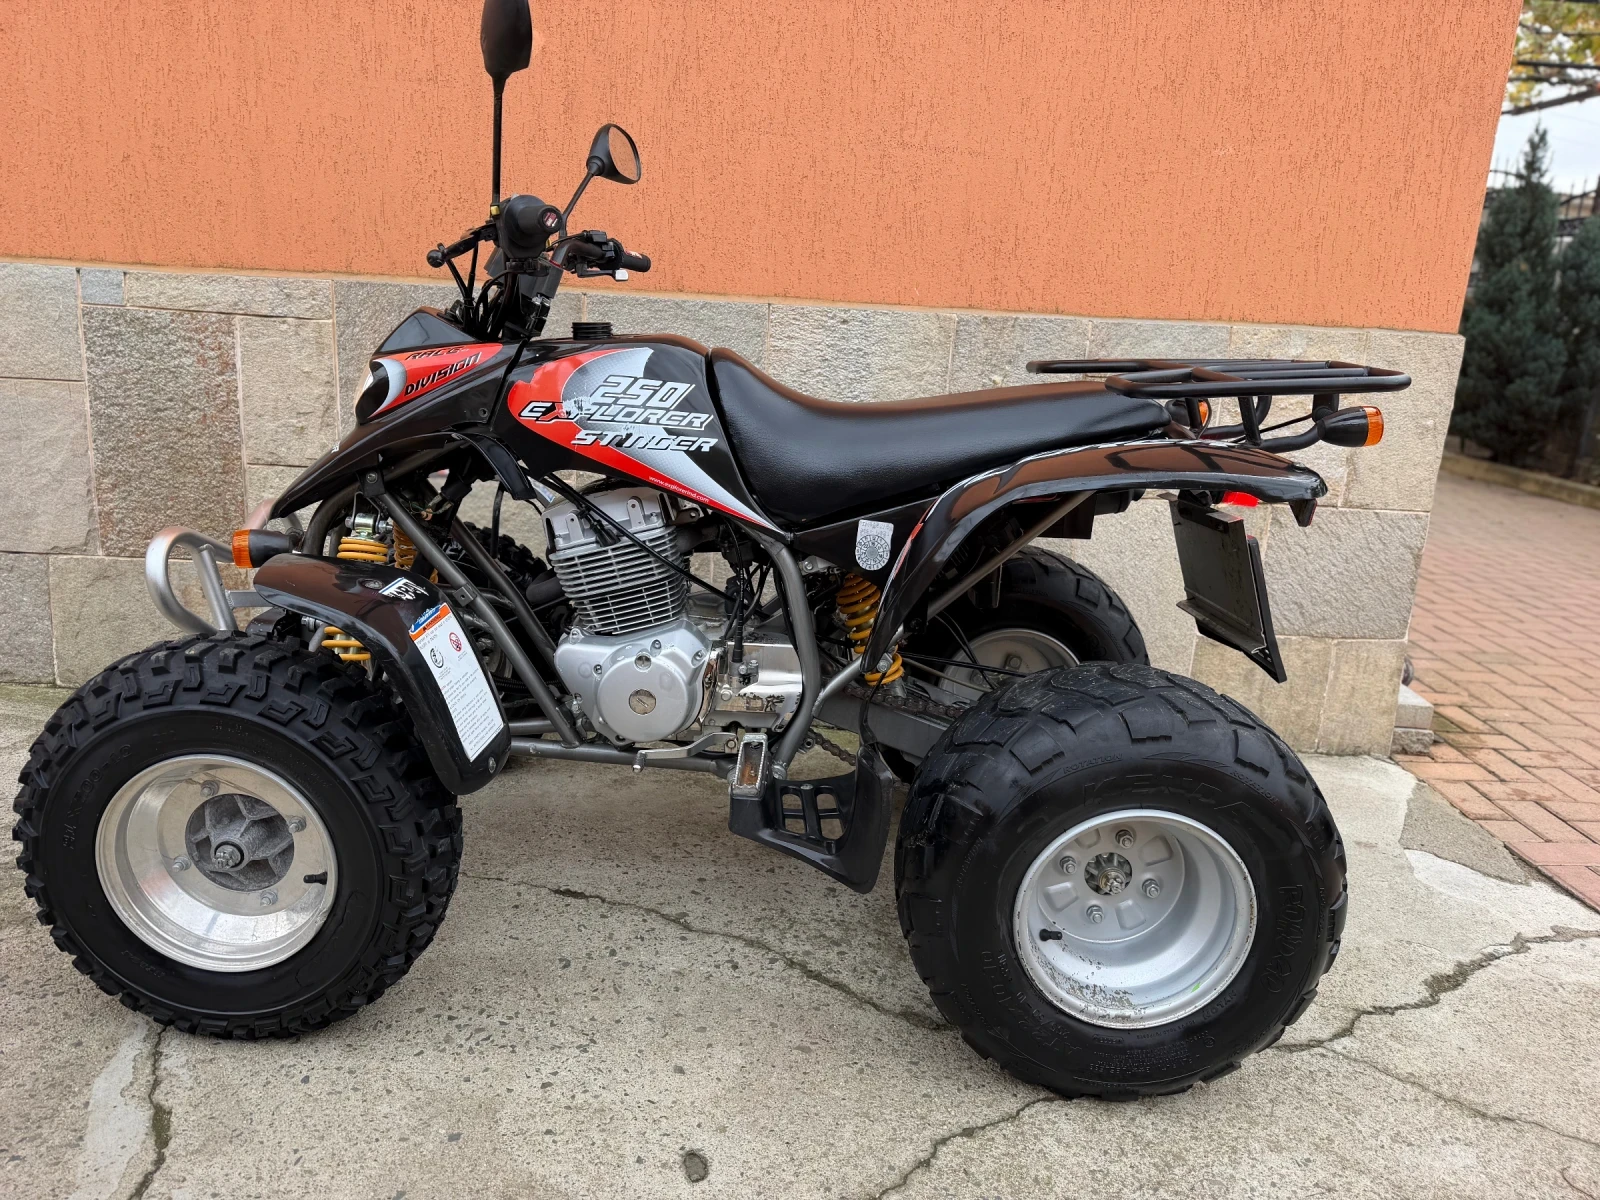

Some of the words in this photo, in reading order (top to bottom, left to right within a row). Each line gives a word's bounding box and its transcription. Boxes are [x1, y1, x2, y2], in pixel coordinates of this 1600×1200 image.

[404, 352, 482, 396] DIVISION
[590, 375, 695, 409] 250
[648, 475, 710, 503] www.explorerind.com
